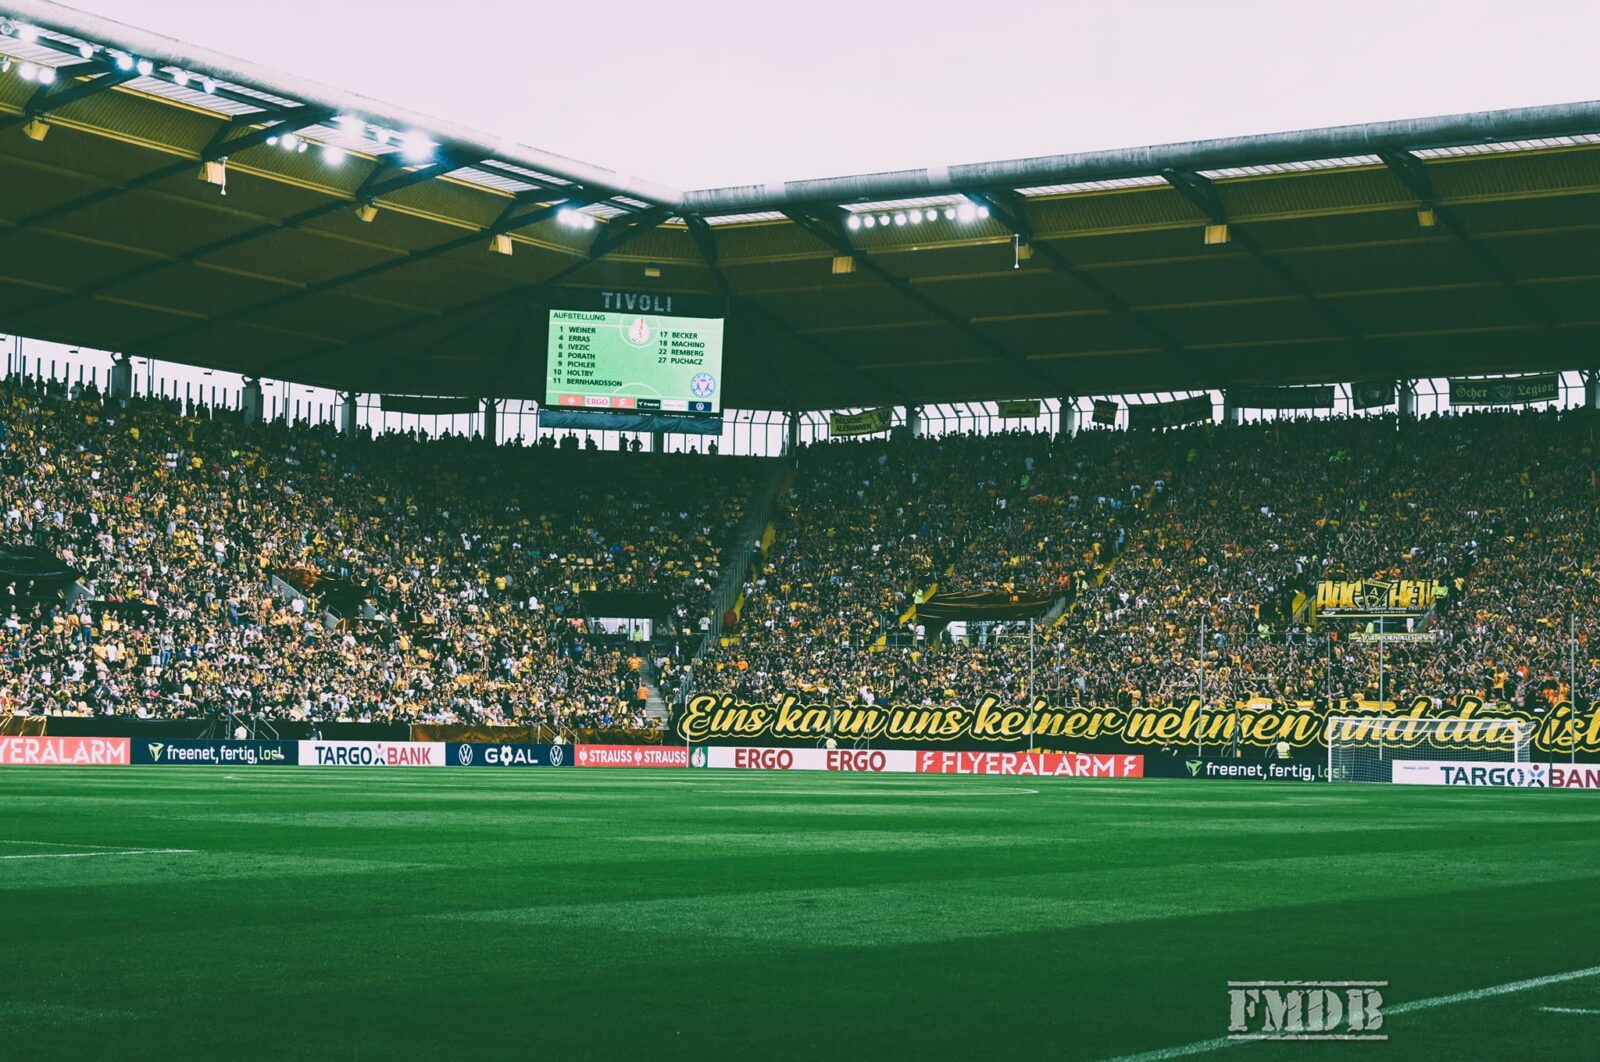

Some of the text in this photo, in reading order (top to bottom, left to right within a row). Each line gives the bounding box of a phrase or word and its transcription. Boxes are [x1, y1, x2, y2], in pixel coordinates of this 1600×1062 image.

[602, 292, 672, 312] TIVOLI
[553, 312, 606, 321] AUFSTELLUNG
[569, 326, 596, 334] WEINER
[672, 332, 698, 340] BECKER
[671, 340, 705, 348] MACHINO
[567, 352, 596, 360] PORATH
[671, 349, 704, 357] REMBERG
[670, 357, 703, 365] PUCHACZ
[567, 369, 594, 377] HOLTBY
[566, 378, 622, 387] BERNHARDSSON
[1517, 382, 1554, 397] Legion
[586, 397, 609, 405] ERGO
[682, 695, 772, 735] Eins
[776, 695, 886, 734] kann
[889, 708, 970, 734] uns
[974, 697, 1123, 737] keiner
[1128, 699, 1320, 742] nehmen
[1325, 699, 1432, 743] und
[1435, 699, 1536, 744] das
[167, 745, 218, 765] freenet,
[220, 745, 258, 765] fertig,
[589, 749, 686, 764] STRAUSS STRAUSS
[734, 749, 793, 770] ERGO
[826, 750, 886, 771] ERGO
[941, 753, 1115, 777] FLYERALARM
[1206, 761, 1267, 781] freenet,
[1269, 763, 1315, 781] fertig,
